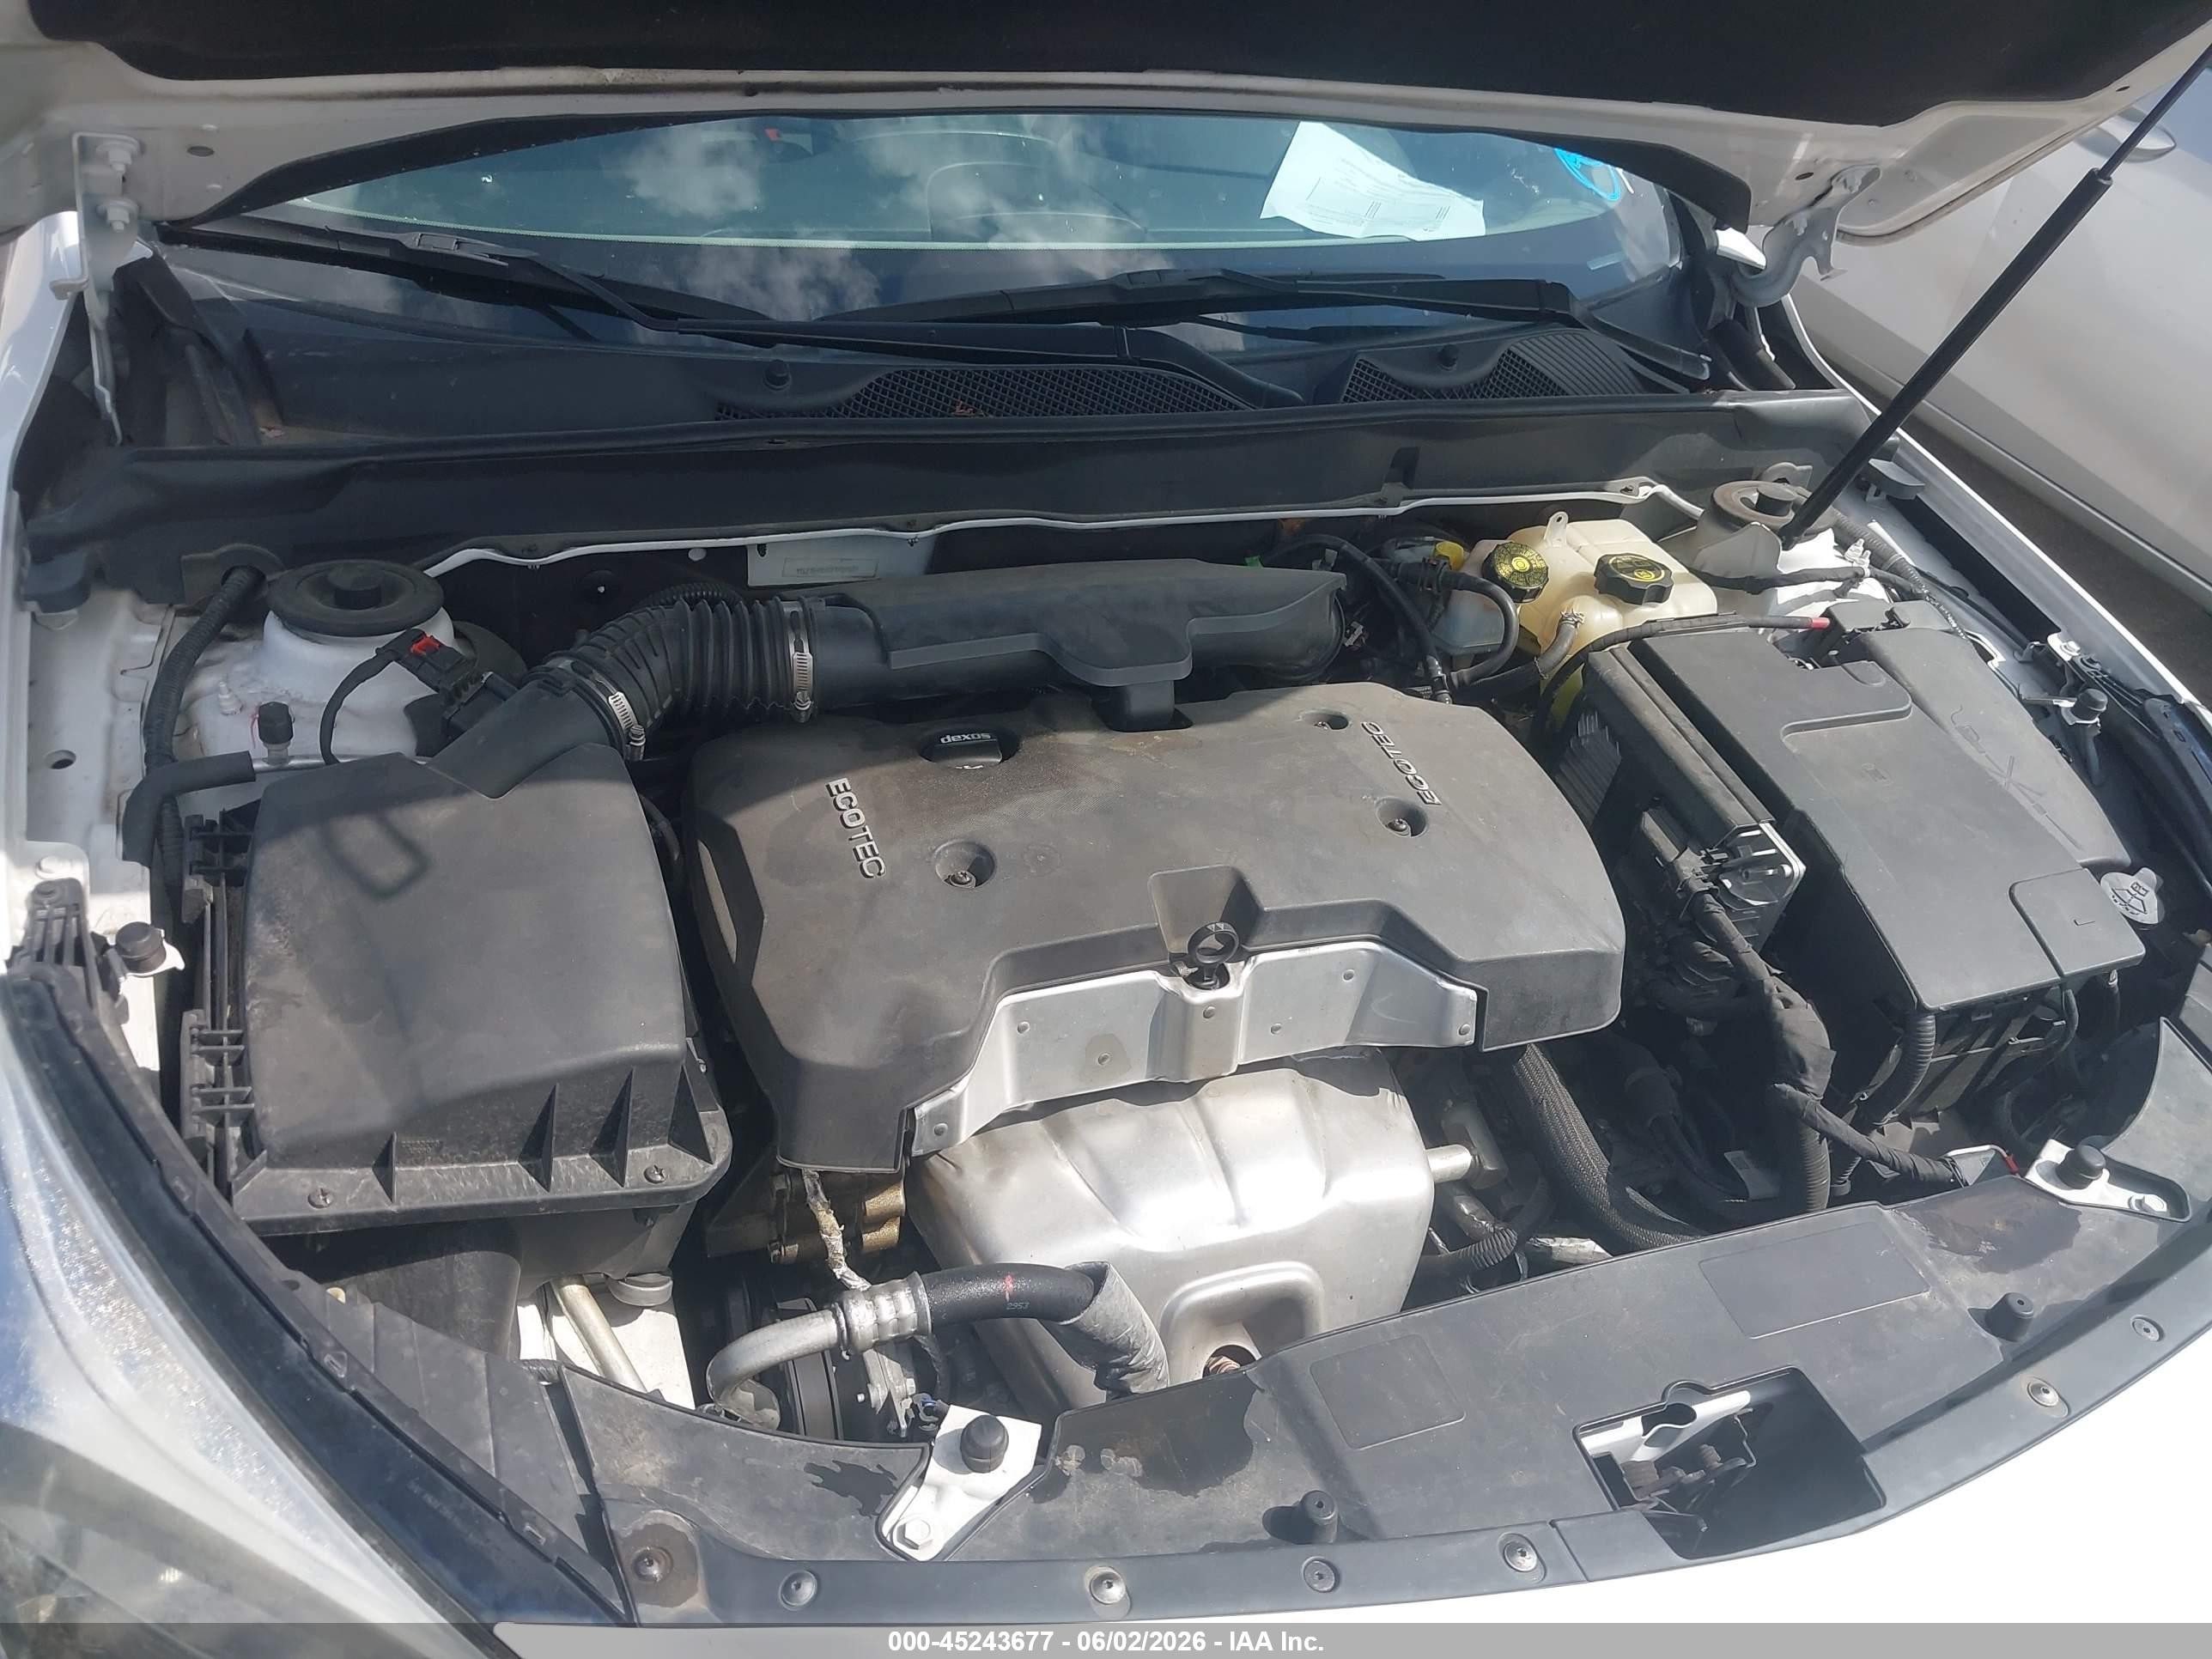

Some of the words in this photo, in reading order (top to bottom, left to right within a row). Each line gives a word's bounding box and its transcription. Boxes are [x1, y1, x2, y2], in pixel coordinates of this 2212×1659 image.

[940, 732, 991, 744] dexos
[1360, 721, 1442, 805] ECOTEC
[825, 778, 886, 878] ECOTEC
